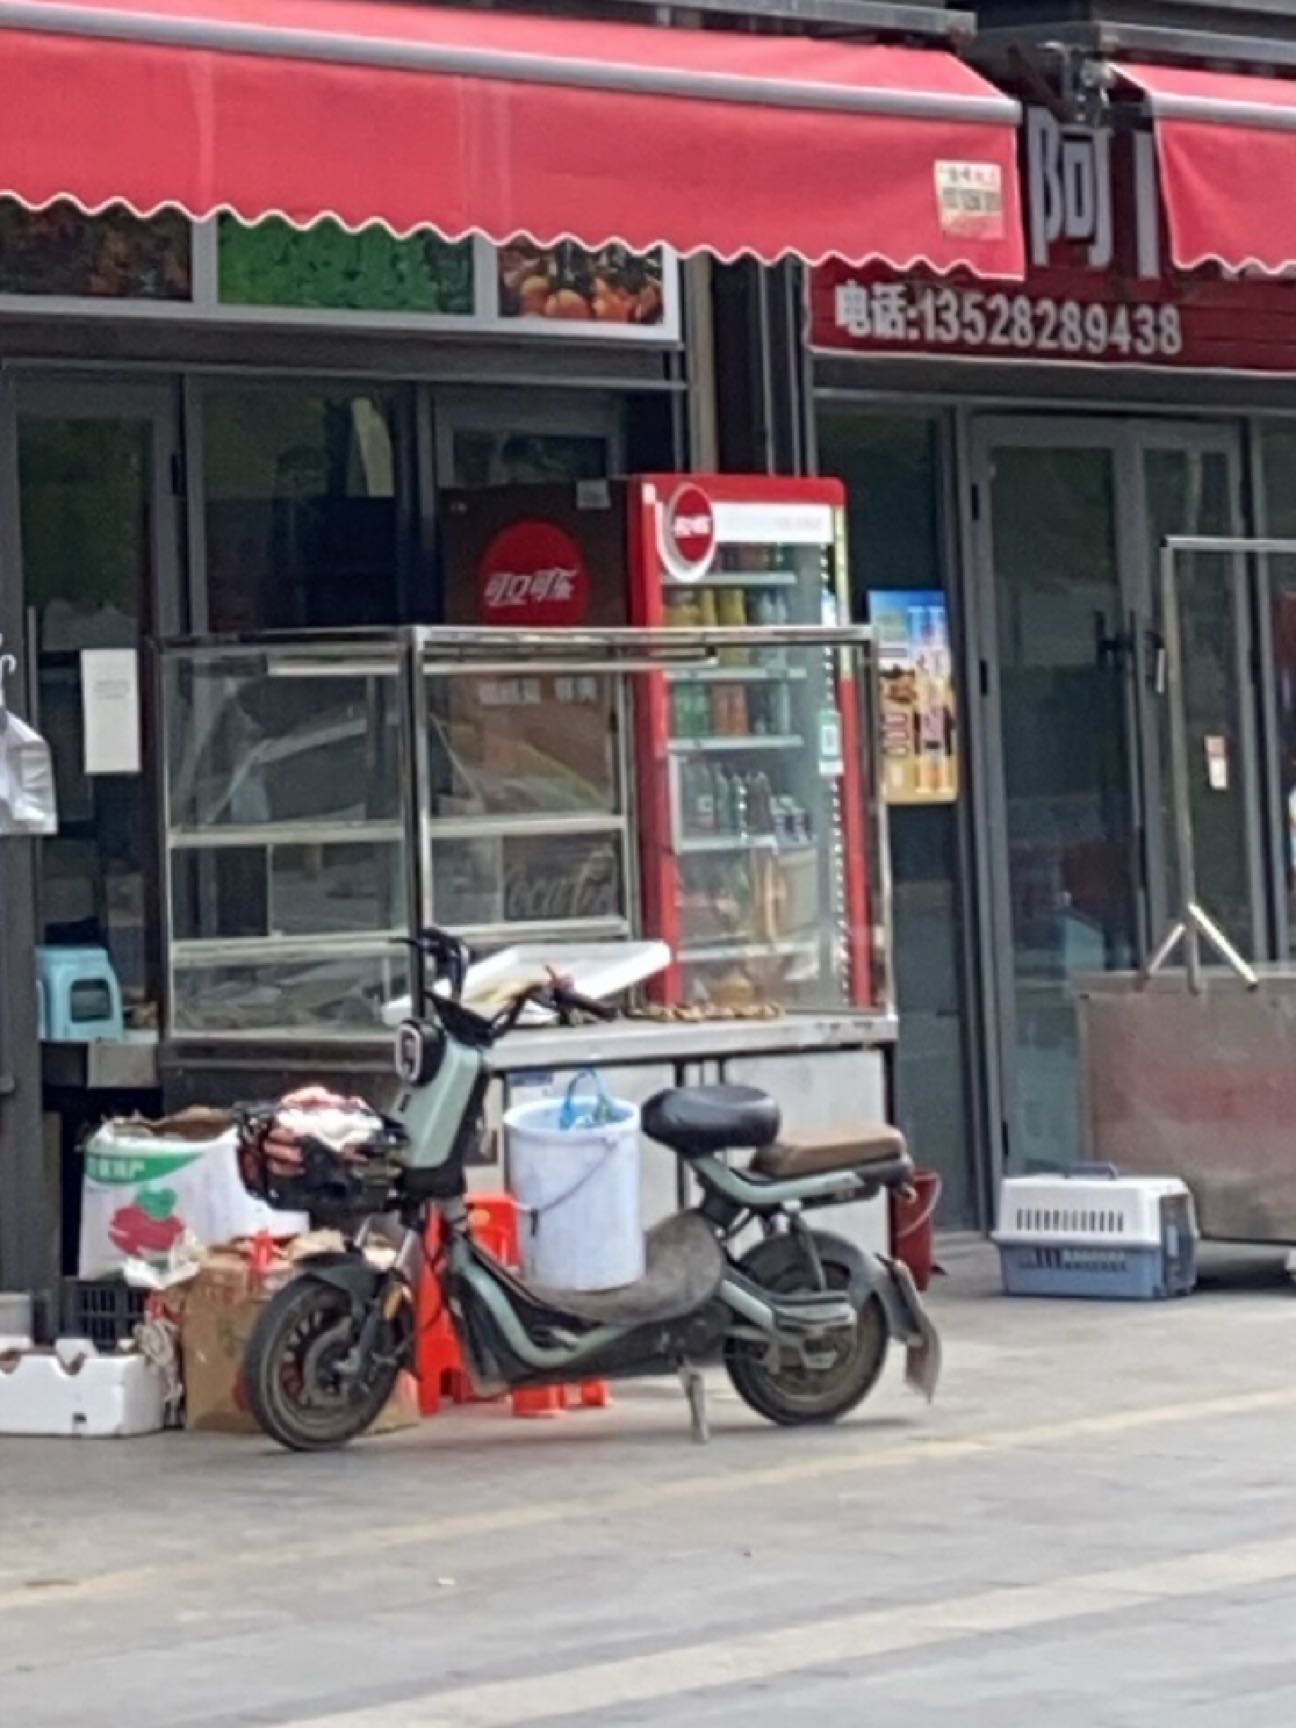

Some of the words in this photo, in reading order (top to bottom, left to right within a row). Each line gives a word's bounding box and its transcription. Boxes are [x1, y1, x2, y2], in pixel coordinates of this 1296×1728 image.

[834, 279, 1183, 356] 电话:13528289438
[484, 567, 578, 607] 可口可乐
